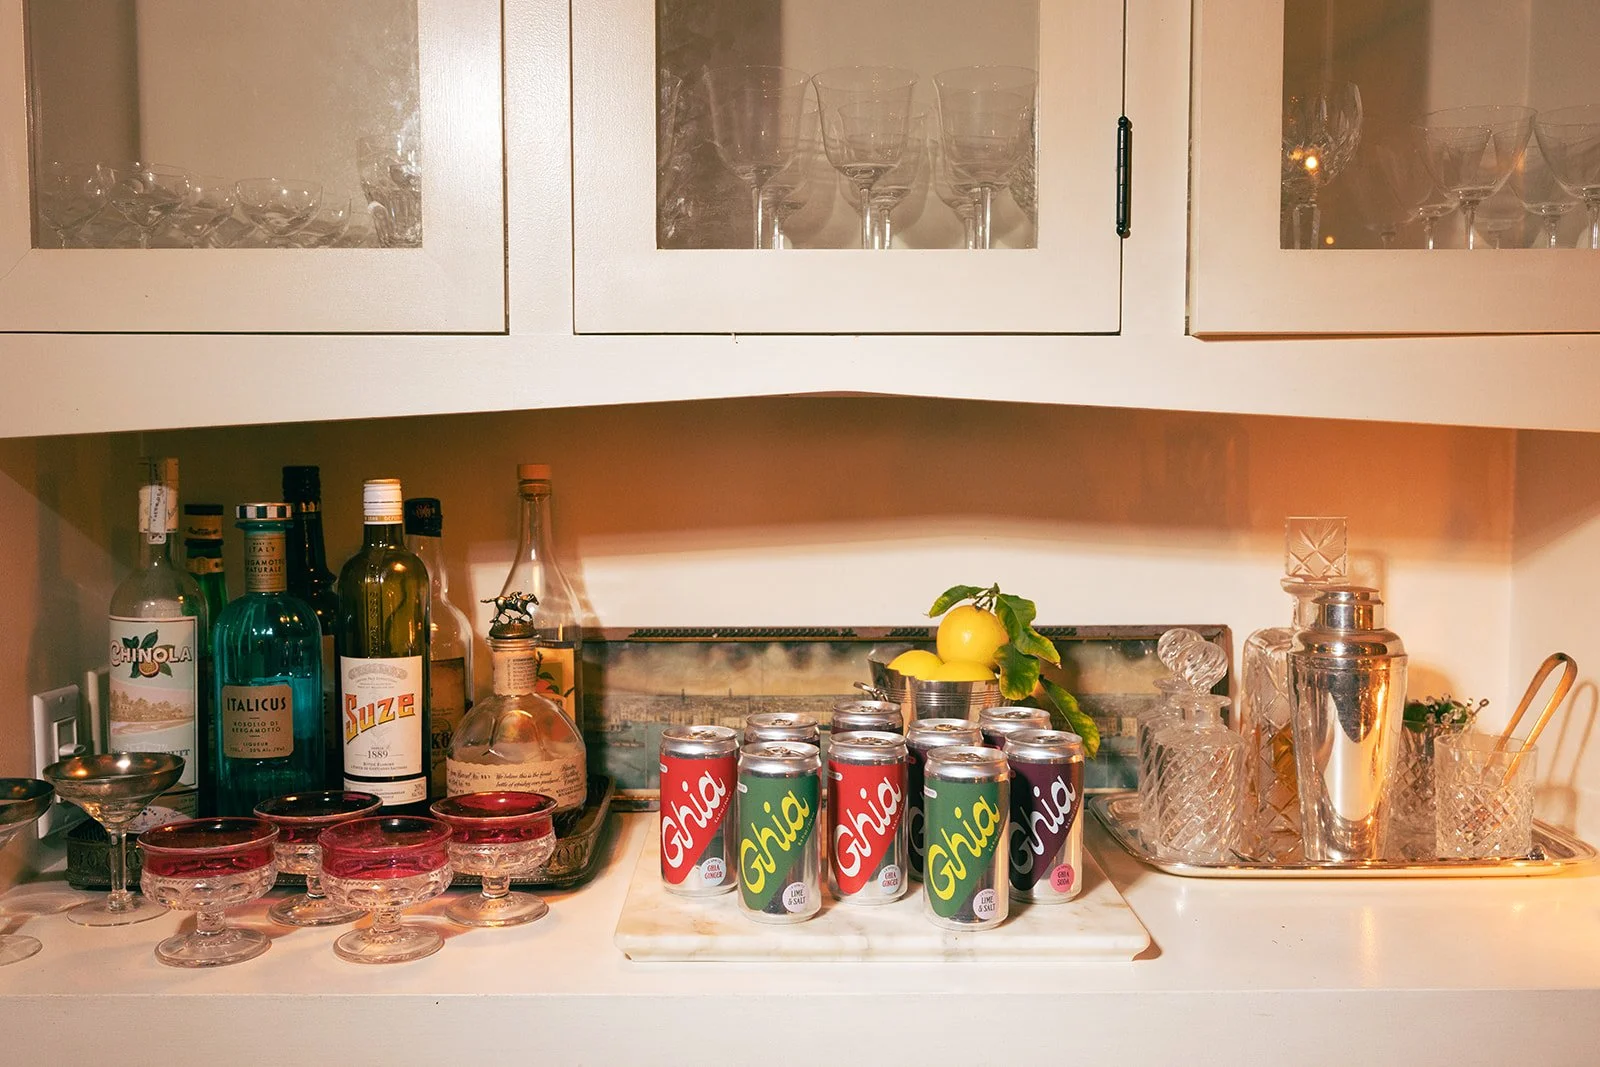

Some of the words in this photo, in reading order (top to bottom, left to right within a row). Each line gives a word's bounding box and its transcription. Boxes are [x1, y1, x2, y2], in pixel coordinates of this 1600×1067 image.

[110, 640, 192, 667] CHINOLA
[227, 697, 286, 712] ITALICUS
[345, 693, 416, 745] Suze
[367, 750, 388, 758] 1889
[662, 770, 726, 868] Ghia
[834, 777, 901, 877] Ghia
[1009, 775, 1076, 875] Ghia
[740, 790, 810, 894] Ghia
[928, 795, 1000, 901] Ghia
[791, 888, 803, 897] LIME
[793, 896, 806, 905] SALT
[981, 896, 994, 905] LIME
[978, 904, 983, 912] &
[984, 903, 996, 912] SALT
